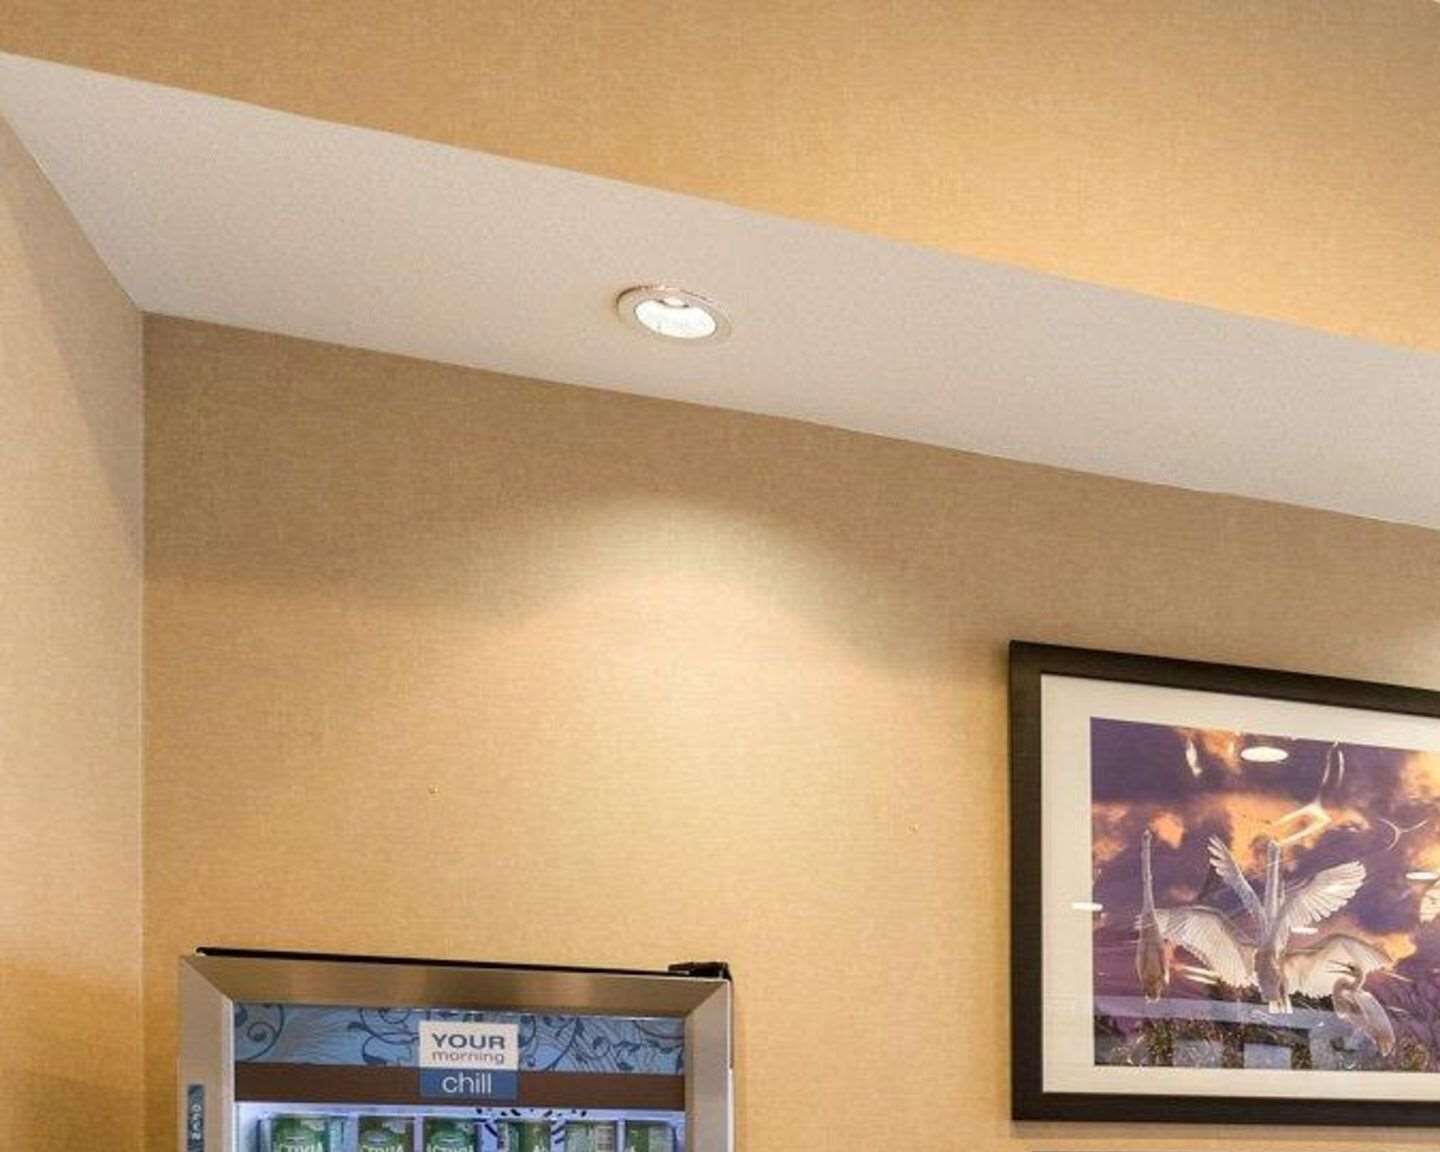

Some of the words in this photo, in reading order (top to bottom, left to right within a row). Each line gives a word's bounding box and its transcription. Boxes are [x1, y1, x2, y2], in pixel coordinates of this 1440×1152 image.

[431, 1033, 505, 1050] YOUR
[432, 1051, 505, 1065] morning
[441, 1071, 492, 1094] chill
